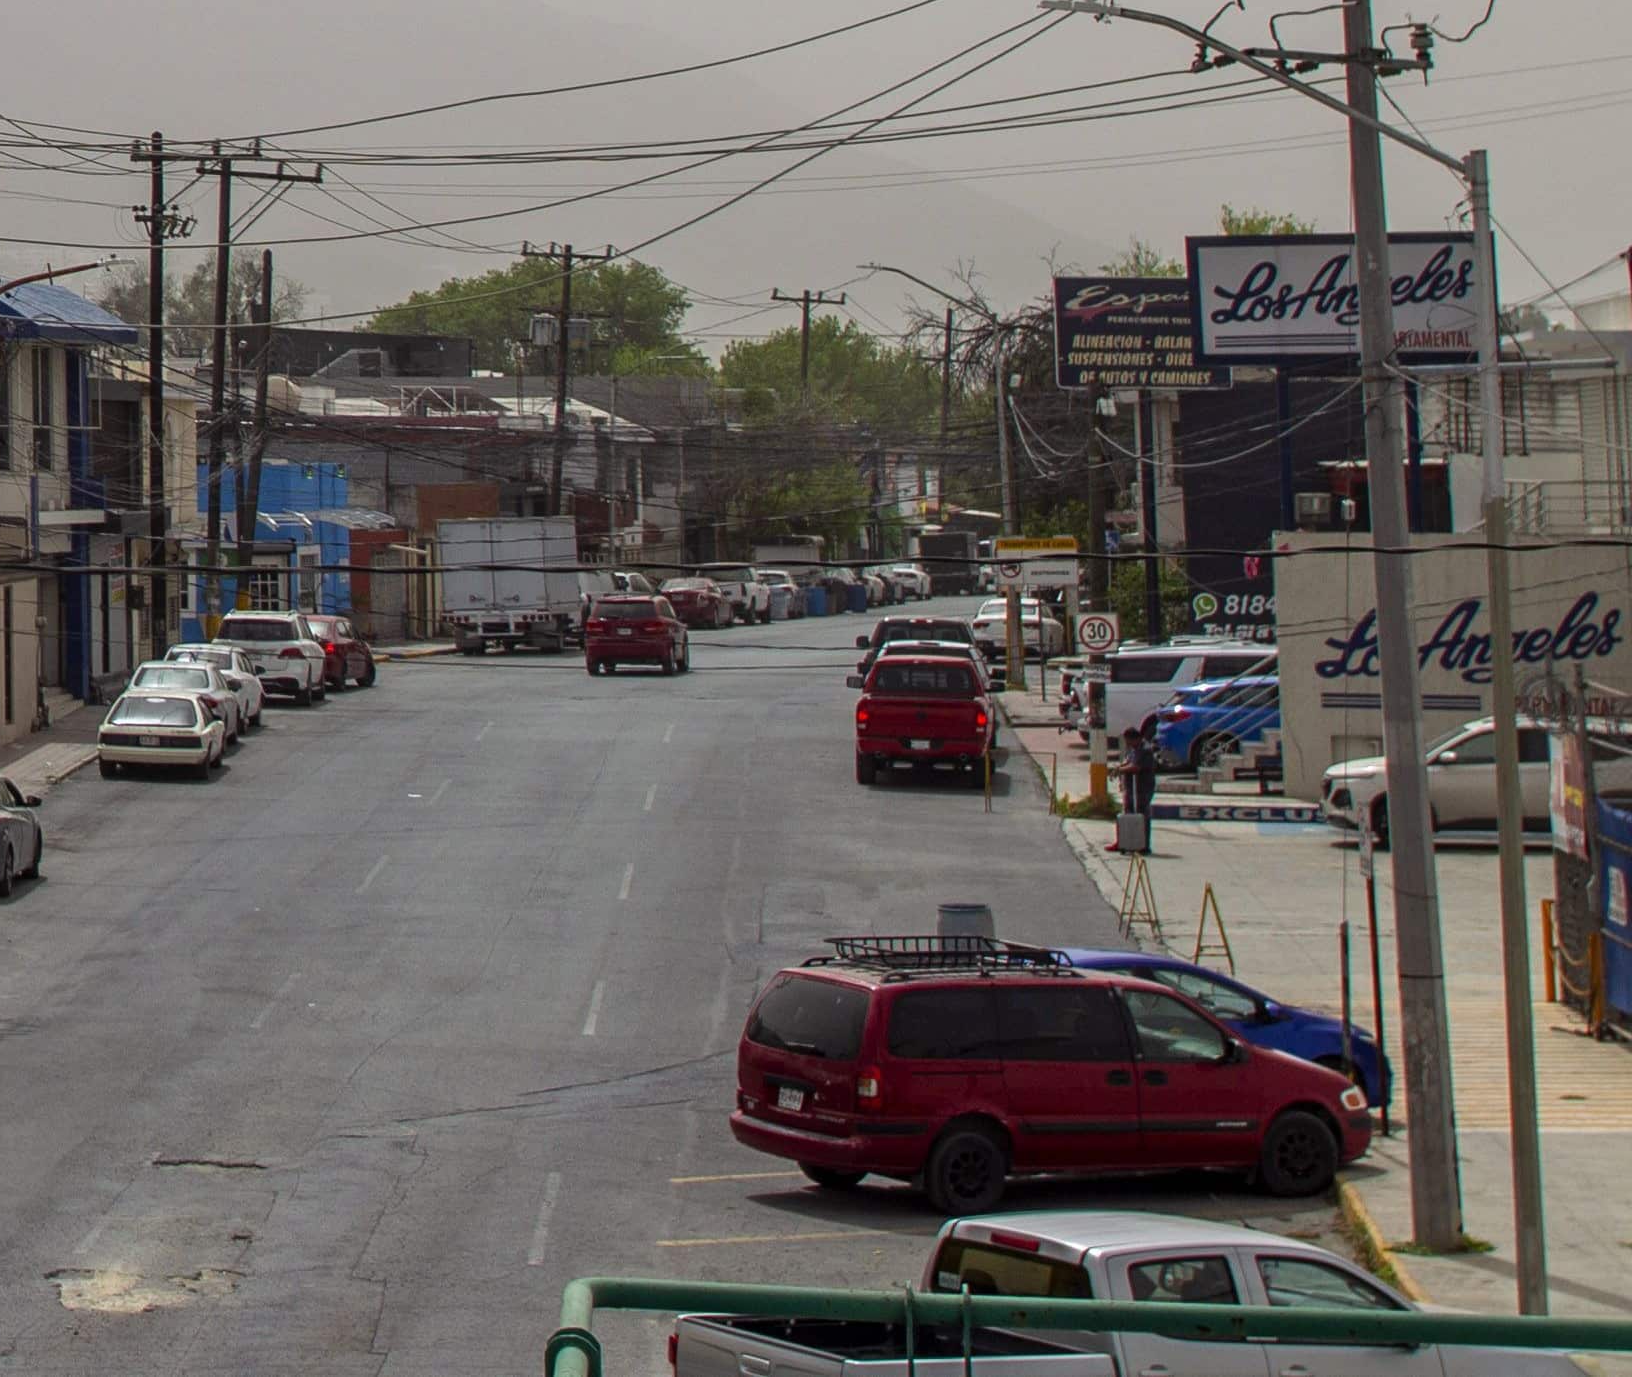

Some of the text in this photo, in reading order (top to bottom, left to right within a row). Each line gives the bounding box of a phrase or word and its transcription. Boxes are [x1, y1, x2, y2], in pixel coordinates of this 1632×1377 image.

[1211, 244, 1474, 326] Los Aneles
[1067, 352, 1155, 366] SUSPENSIONES
[1139, 371, 1148, 385] Y
[1150, 371, 1212, 385] CAMIONES
[1086, 622, 1106, 640] 30
